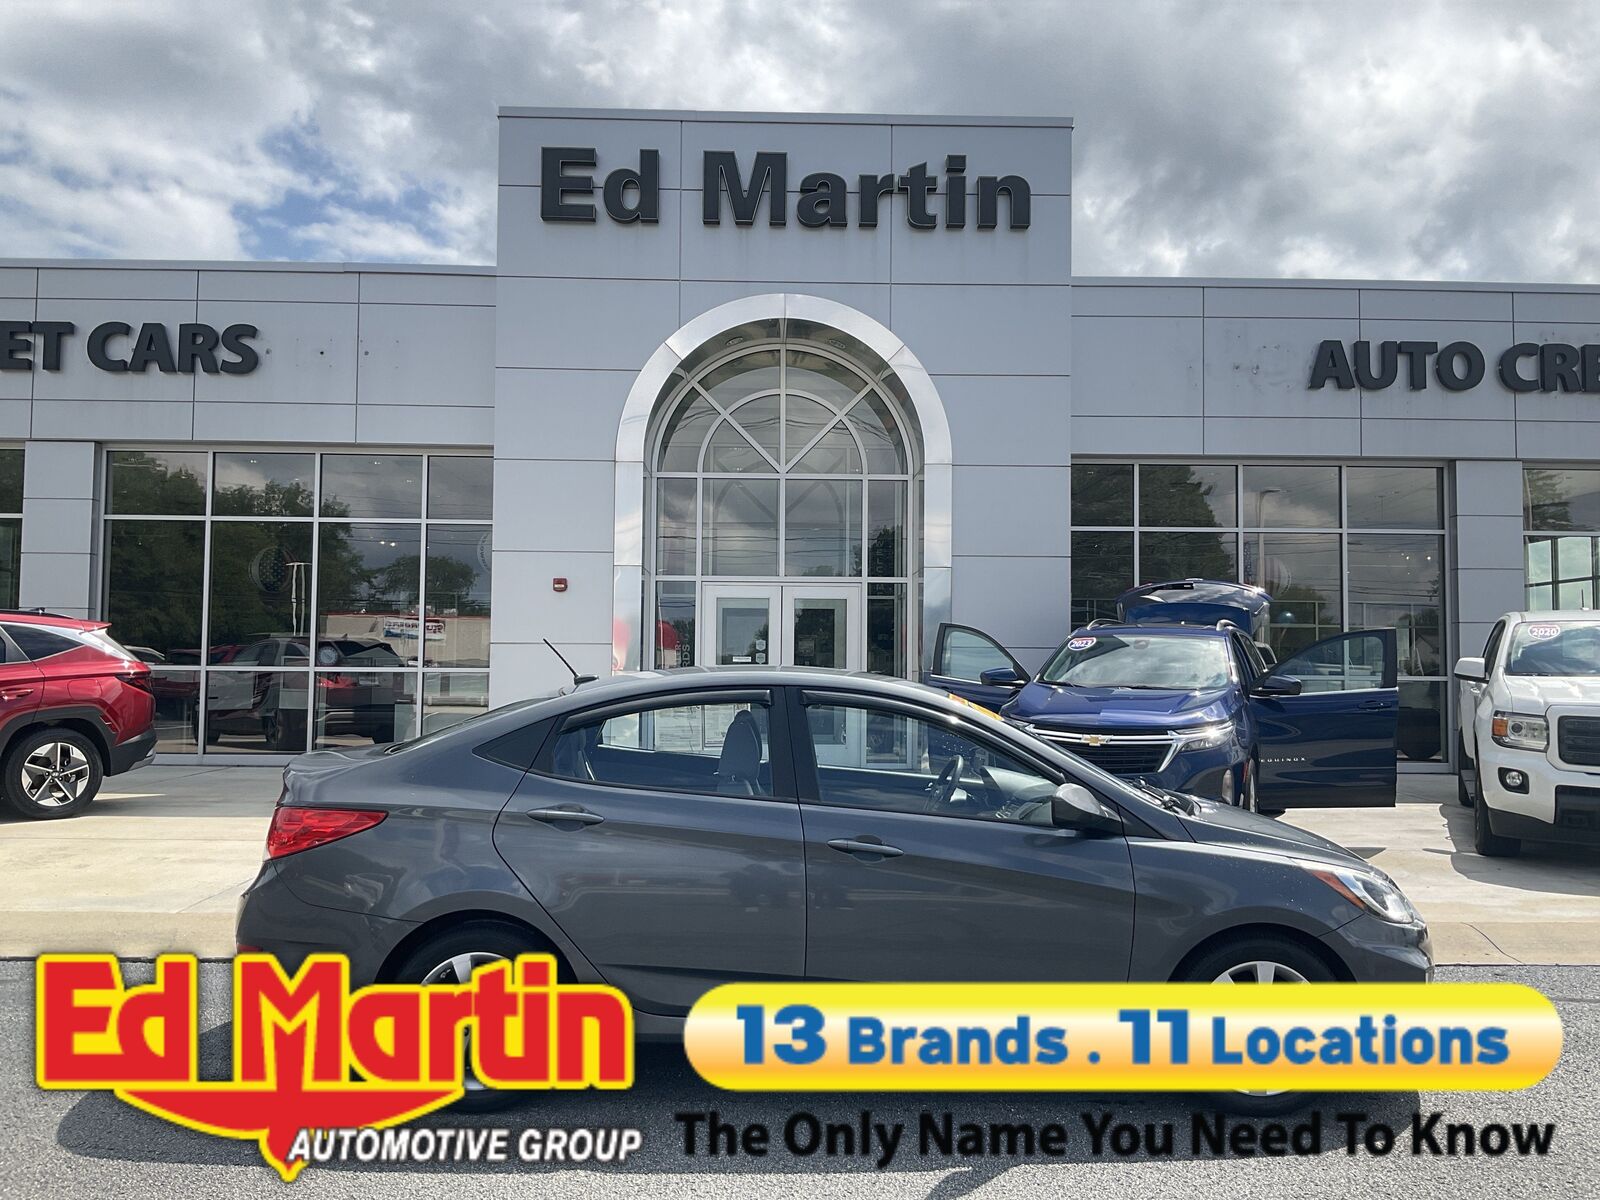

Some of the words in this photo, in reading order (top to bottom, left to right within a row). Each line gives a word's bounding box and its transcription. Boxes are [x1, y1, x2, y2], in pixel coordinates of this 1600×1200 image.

[541, 147, 660, 224] Ed
[702, 150, 1032, 230] Martin
[0, 321, 76, 371] ET
[86, 322, 260, 375] CARS
[1308, 339, 1486, 392] AUTO
[1531, 627, 1558, 637] 2020
